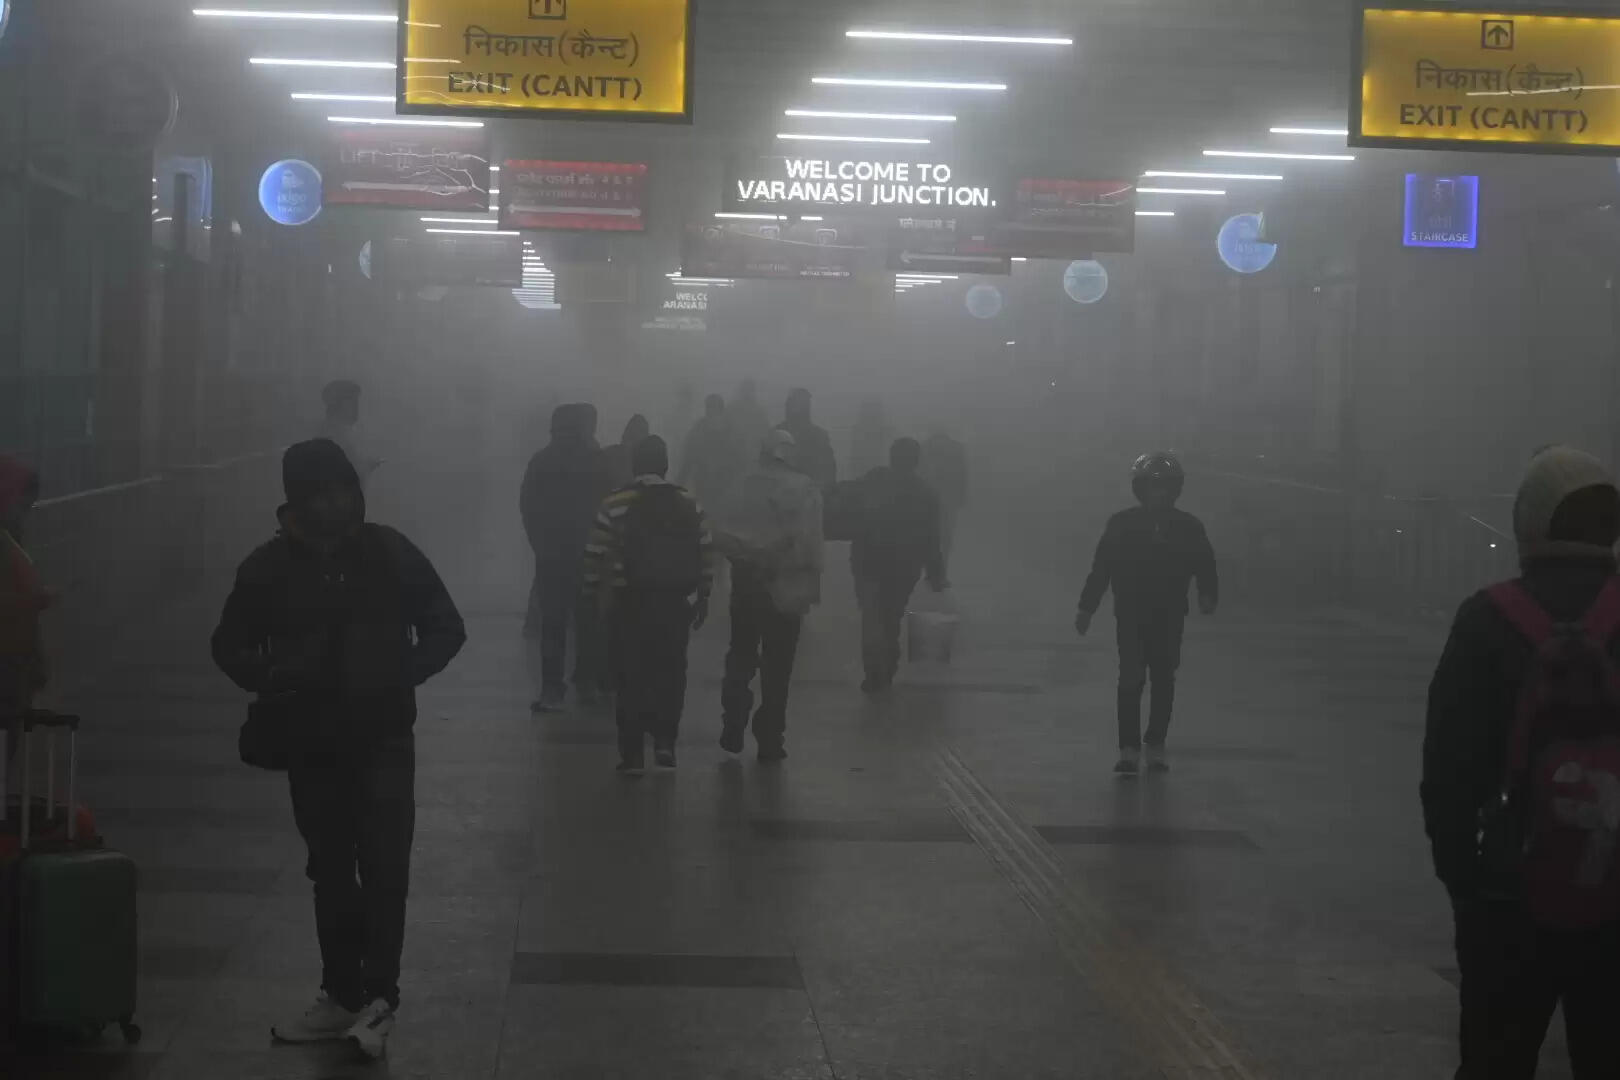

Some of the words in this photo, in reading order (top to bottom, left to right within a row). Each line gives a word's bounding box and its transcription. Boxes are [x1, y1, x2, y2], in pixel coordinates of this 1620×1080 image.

[448, 71, 513, 94] EXIT
[521, 74, 642, 101] (CANTT)
[1400, 103, 1463, 127] EXIT
[1470, 106, 1588, 134] (CANTT)
[785, 159, 909, 181] WELCOME
[917, 163, 951, 183] TO
[738, 180, 862, 203] VARANASI
[870, 183, 997, 207] JUNCTION.
[1411, 231, 1469, 243] STAIRCASE
[663, 300, 707, 309] ARANASI
